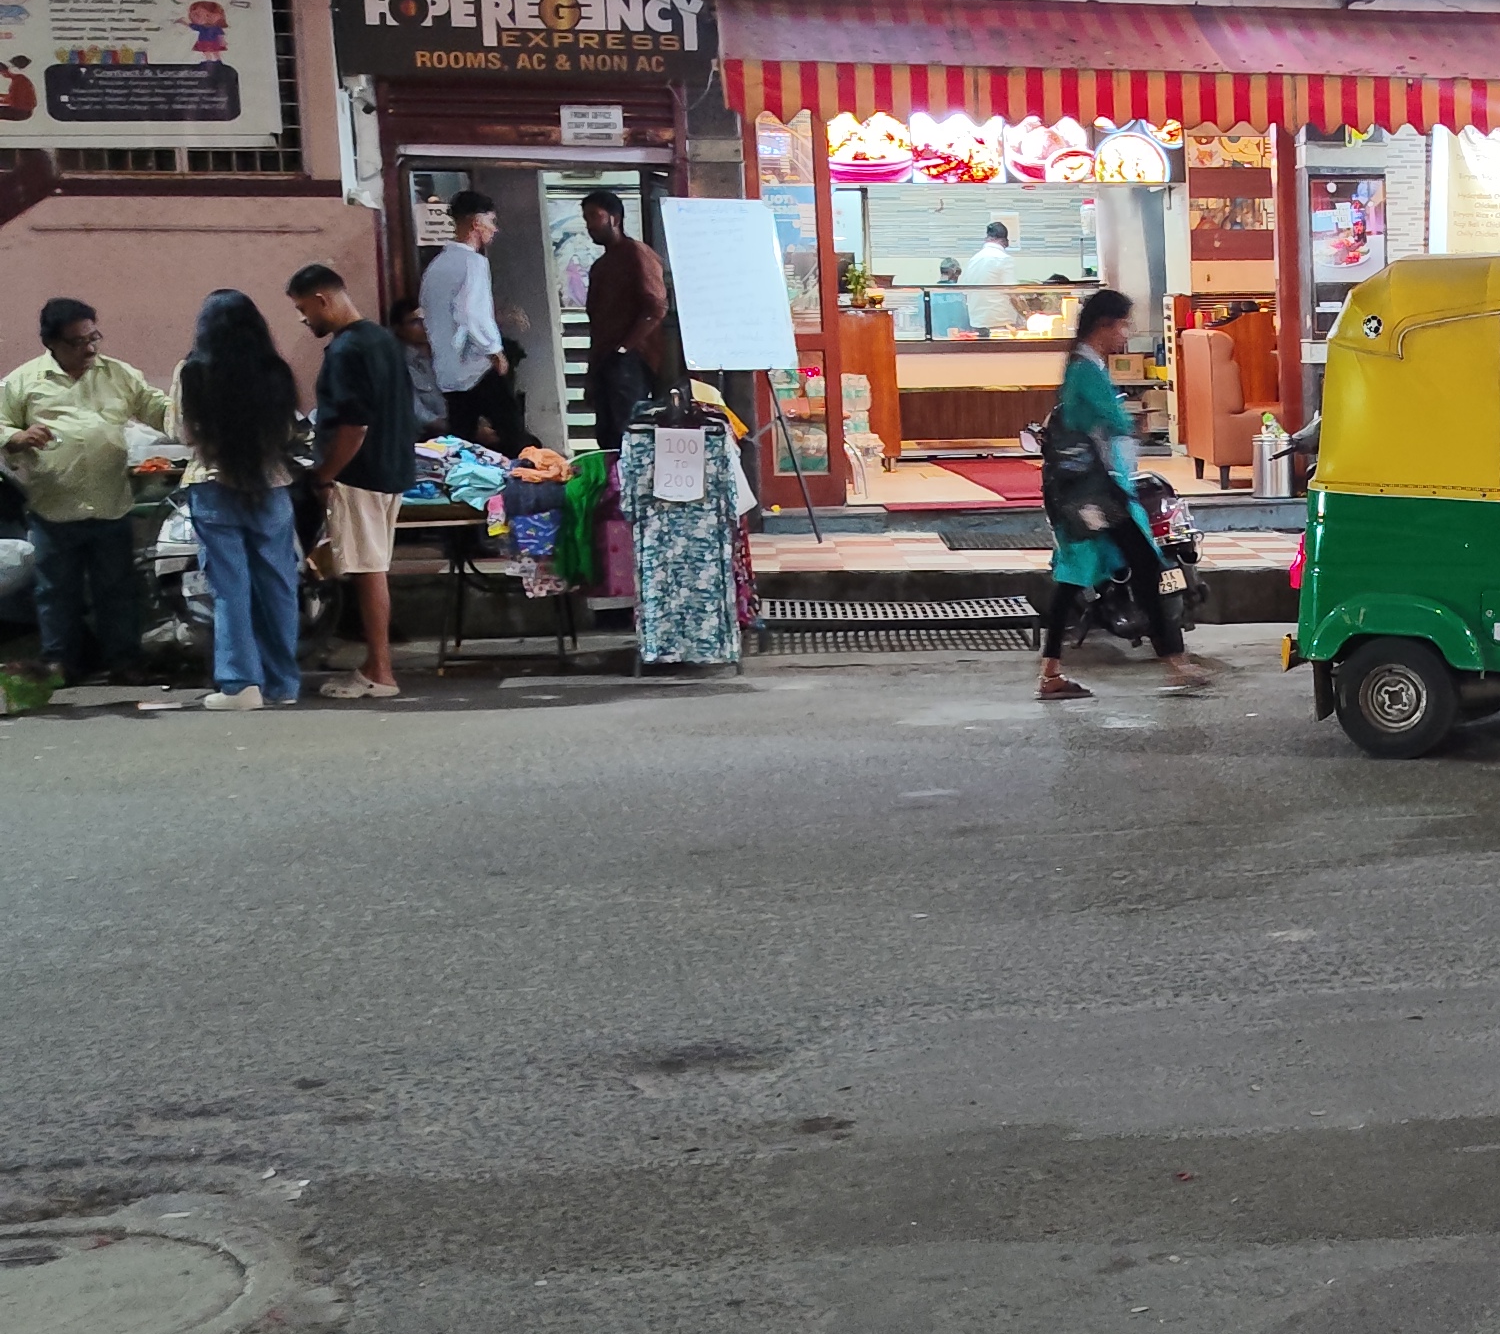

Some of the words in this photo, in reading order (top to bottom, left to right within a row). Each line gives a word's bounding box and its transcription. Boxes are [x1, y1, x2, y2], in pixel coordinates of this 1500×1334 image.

[501, 31, 681, 51] EXPRESS
[516, 53, 546, 71] AC
[554, 53, 572, 72] &
[579, 54, 628, 72] NON
[635, 55, 666, 72] AC
[665, 438, 699, 455] 100
[663, 473, 695, 488] 200
